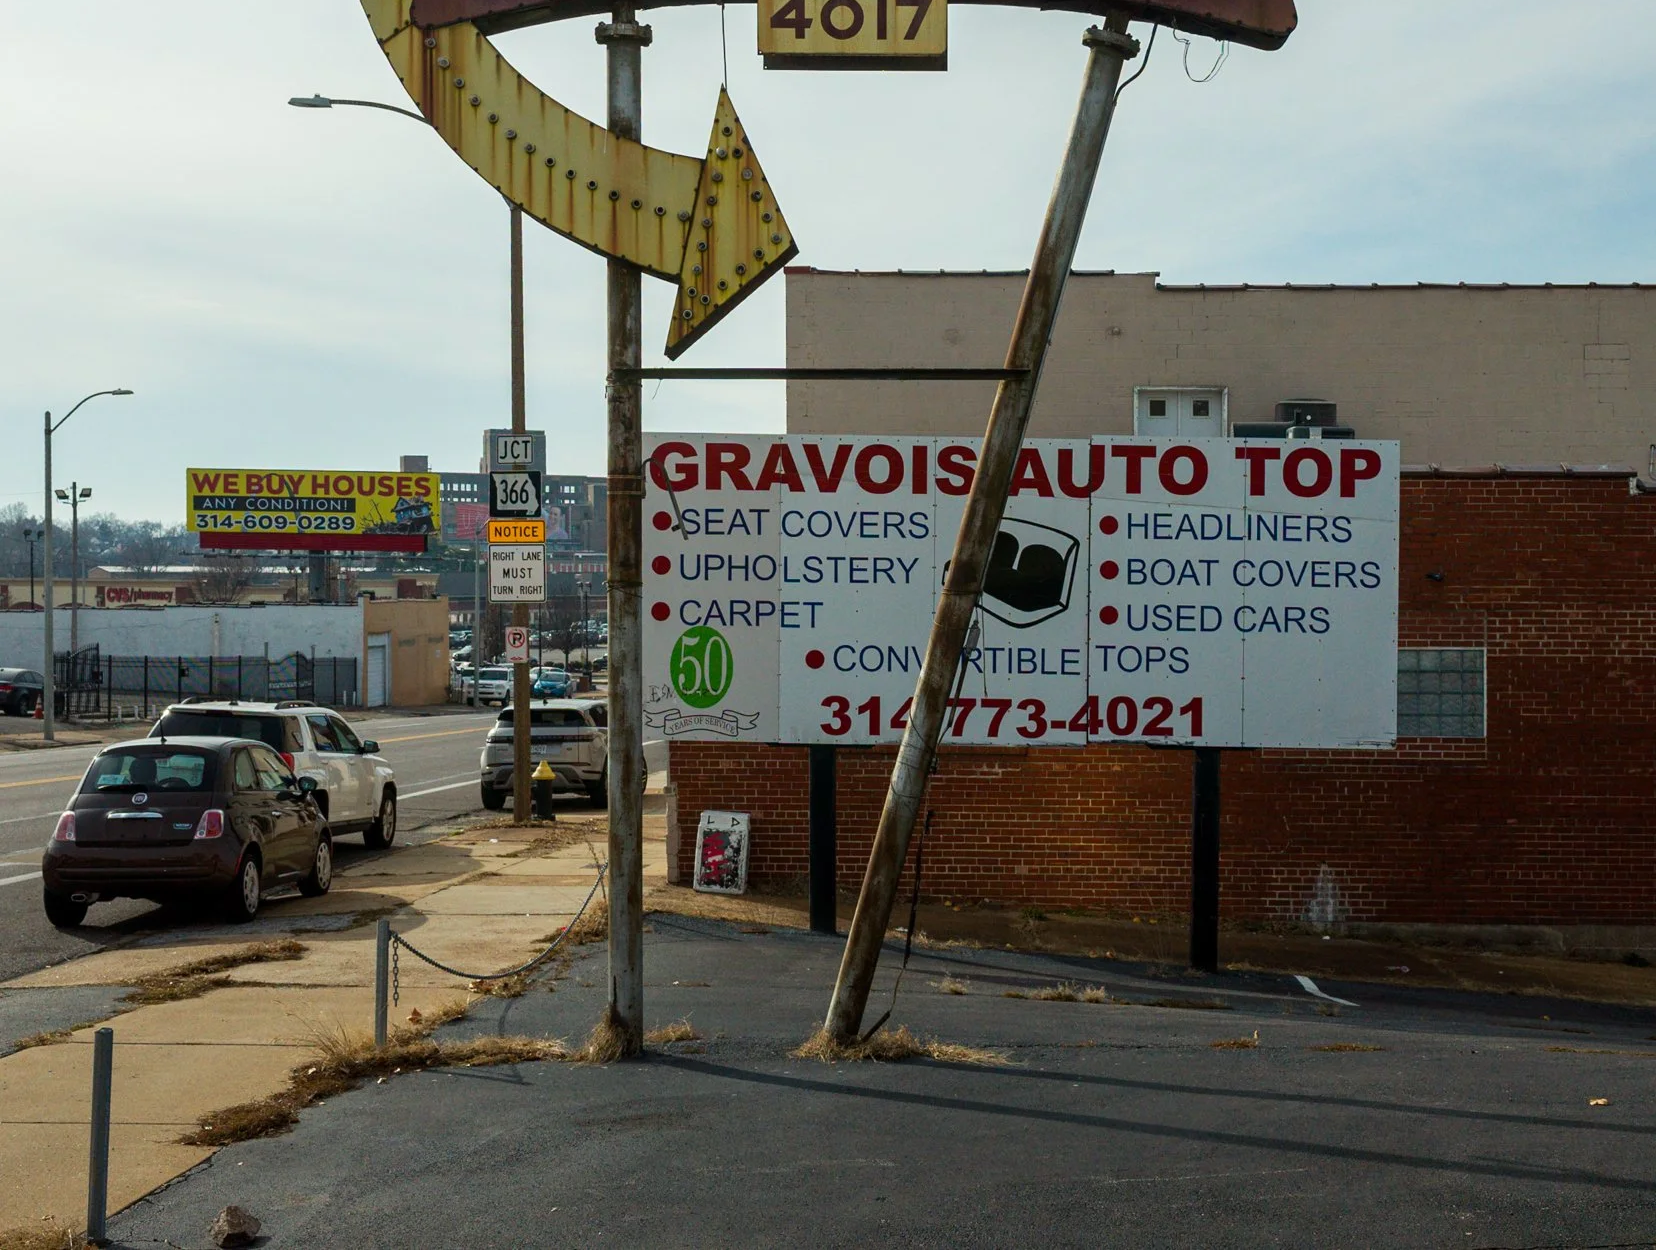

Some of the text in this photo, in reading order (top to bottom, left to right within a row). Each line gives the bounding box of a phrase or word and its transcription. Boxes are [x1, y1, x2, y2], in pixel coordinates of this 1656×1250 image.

[499, 440, 531, 459] JCT
[650, 442, 1381, 498] GRAVOIS AUTO TOP
[191, 473, 431, 497] WE BUY HOUSES
[500, 479, 529, 504] 366
[203, 498, 348, 511] ANY CONDITION!
[196, 513, 356, 531] 314-609-0289
[494, 526, 539, 538] NOTICE
[681, 509, 930, 539] SEAT COVERS
[1127, 513, 1352, 543] HEADLINERS
[492, 551, 542, 561] RIGHT LANE
[503, 567, 533, 579] MUST
[680, 554, 919, 584] UPHOLSTERY
[1127, 559, 1381, 589] BOAT COVERS
[107, 587, 173, 602] CVS/pharmacy
[492, 585, 543, 595] TURN RIGHT
[680, 600, 823, 628] CARPET
[1127, 604, 1330, 634] USED CARS
[678, 635, 727, 695] 50
[834, 645, 1190, 676] CONVRTIBLE TOPS
[669, 718, 693, 733] YEARS
[705, 717, 736, 734] SERVICE
[820, 695, 1203, 739] 314773-4021
